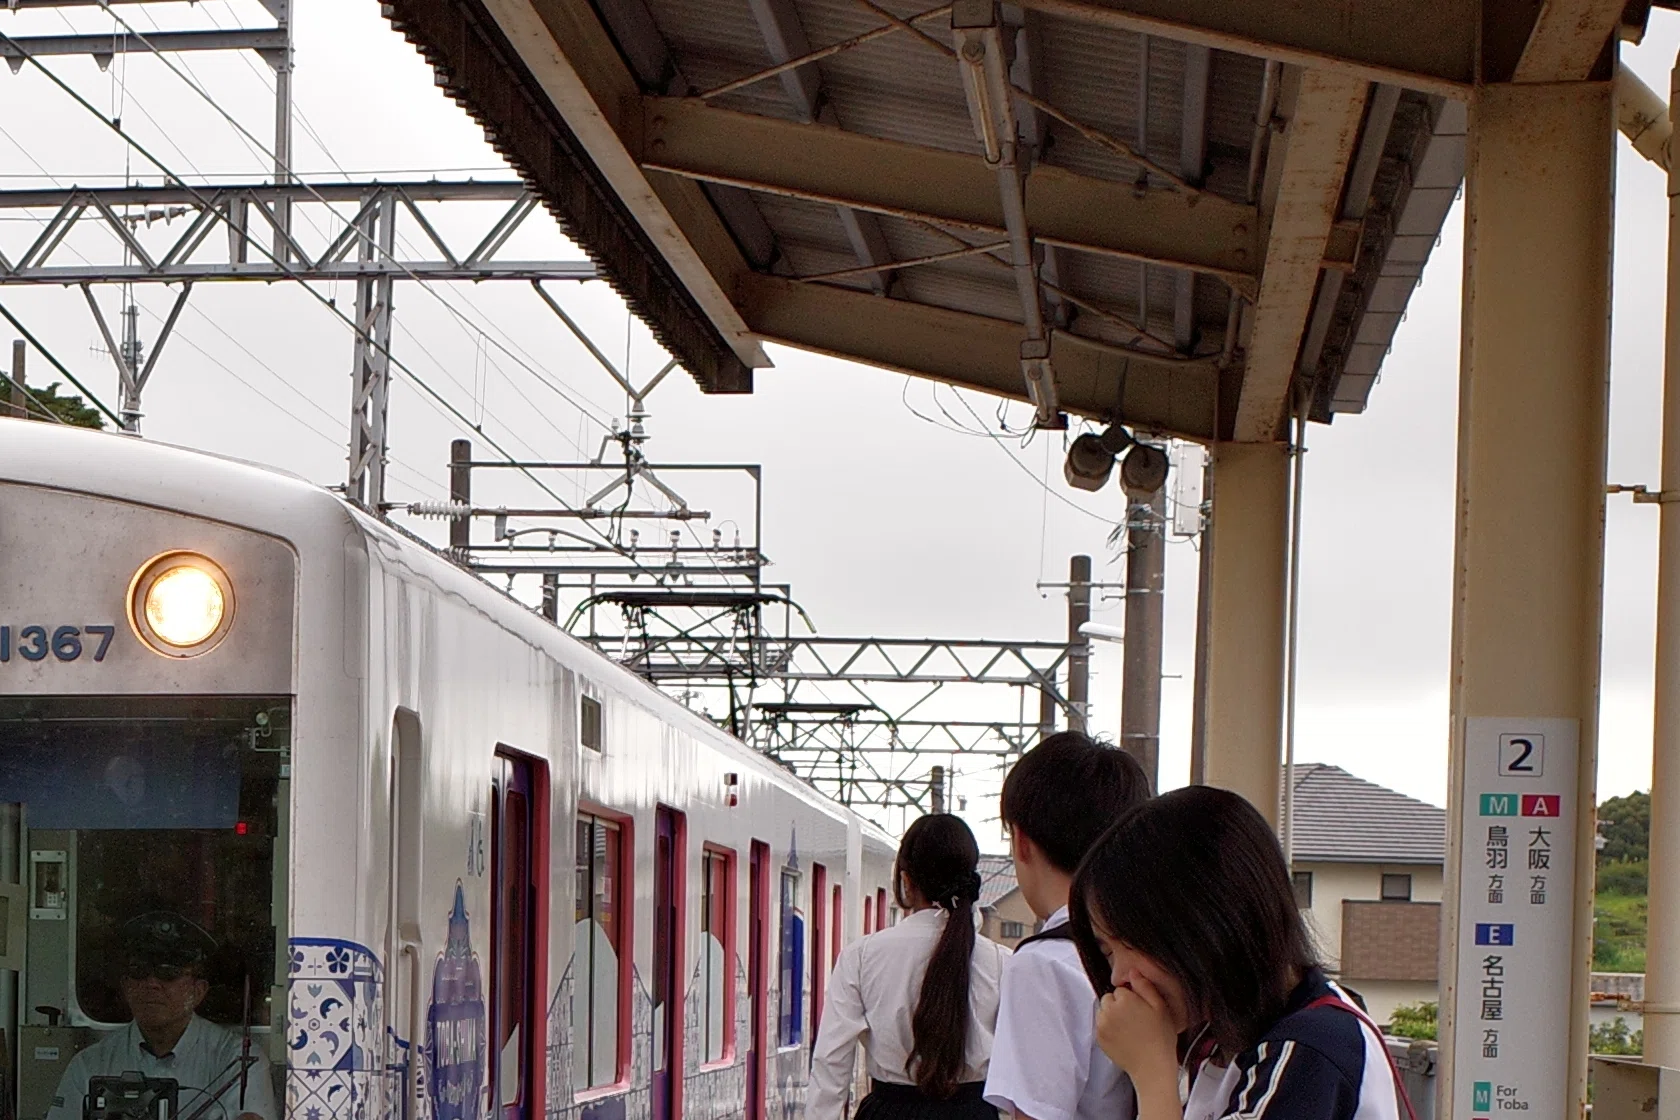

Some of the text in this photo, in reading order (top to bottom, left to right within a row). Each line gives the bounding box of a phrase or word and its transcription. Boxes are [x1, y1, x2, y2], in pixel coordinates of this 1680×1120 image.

[0, 625, 115, 662] 1367
[1508, 739, 1533, 771] 2
[1489, 796, 1508, 815] M
[1531, 797, 1549, 815] A
[1489, 925, 1501, 944] E
[1476, 1085, 1518, 1103] M For
[1495, 1099, 1529, 1110] Toba
